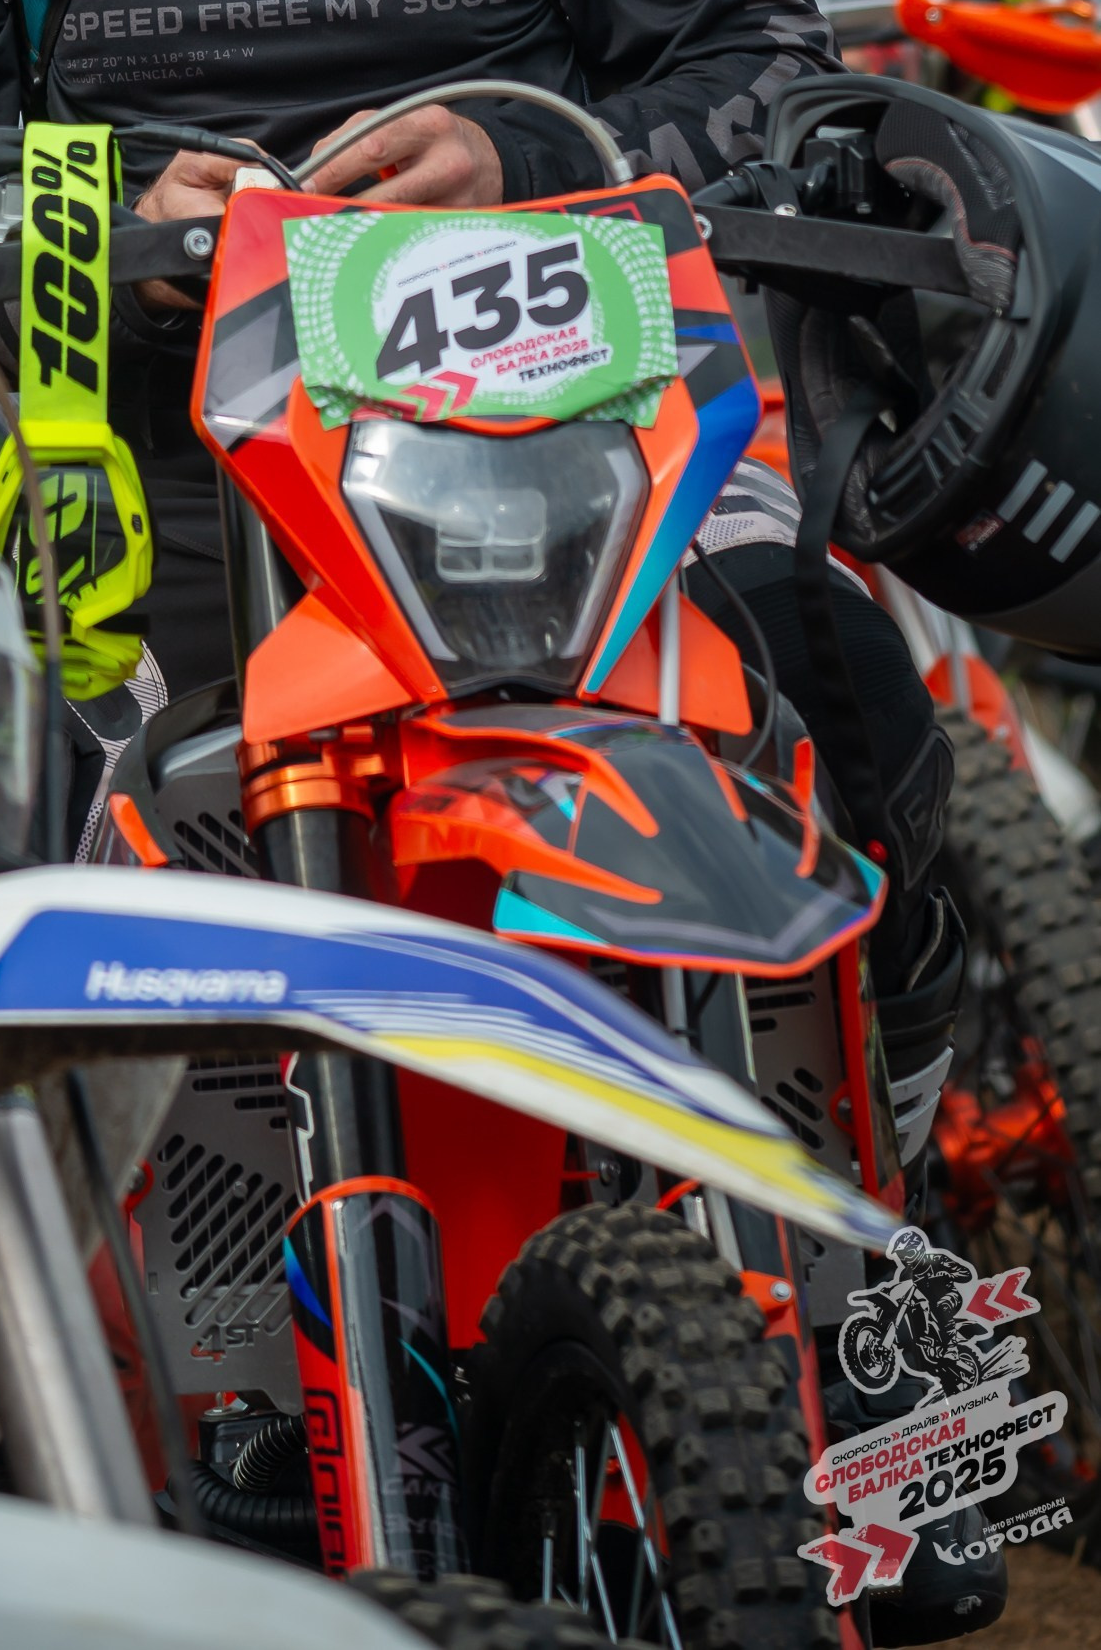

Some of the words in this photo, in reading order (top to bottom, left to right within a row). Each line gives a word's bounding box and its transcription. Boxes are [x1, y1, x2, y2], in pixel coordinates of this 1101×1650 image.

[62, 5, 184, 42] SPEED
[241, 47, 255, 58] W
[108, 68, 182, 84] VALENCIA,
[185, 66, 205, 78] CA
[31, 139, 102, 395] 100%
[375, 241, 590, 381] 435
[470, 325, 579, 369] СЛОБОДСКАЯ
[496, 349, 549, 376] БАЛКА
[518, 349, 609, 384] ТЕХНОФЕСТ
[85, 959, 289, 1008] Husqvarna
